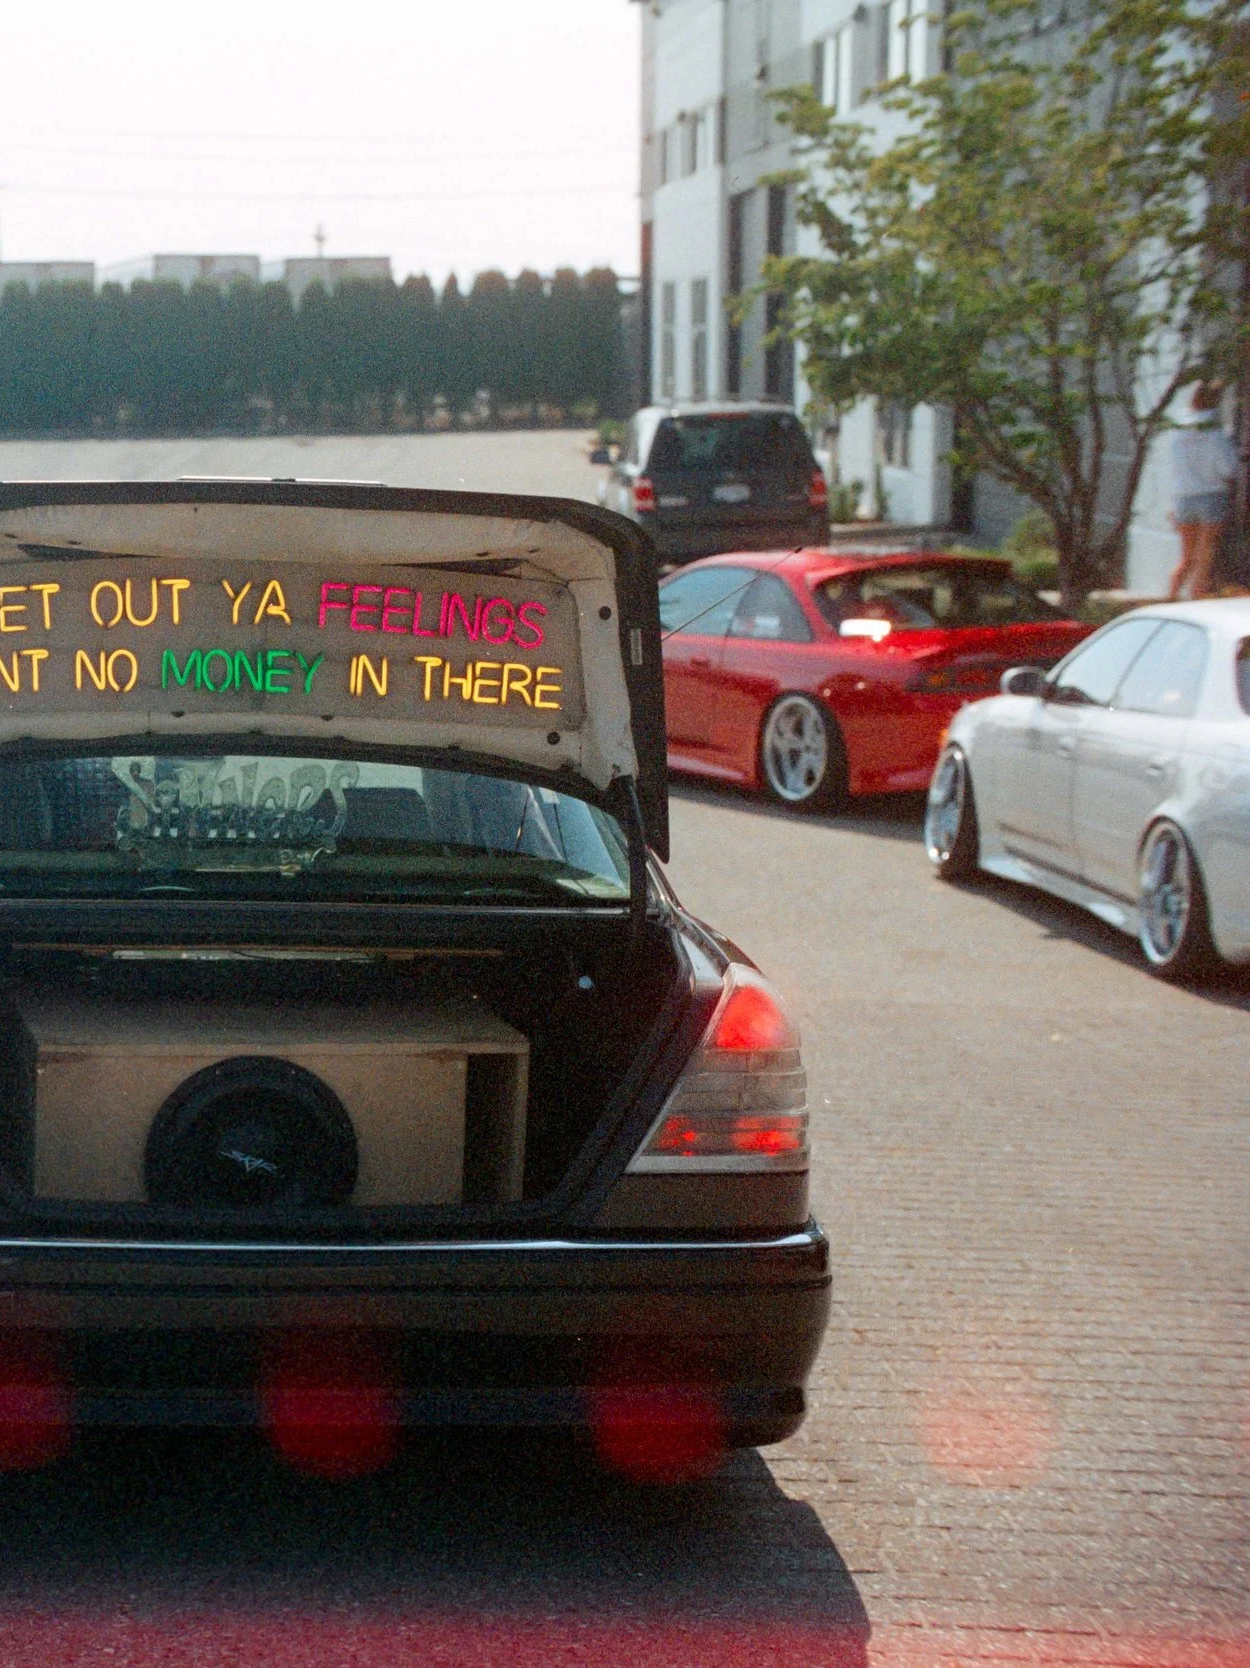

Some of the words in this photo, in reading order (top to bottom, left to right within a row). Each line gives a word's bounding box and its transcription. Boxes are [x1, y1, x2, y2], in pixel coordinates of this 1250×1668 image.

[90, 578, 191, 627] OUT
[223, 579, 292, 625] YA
[319, 582, 547, 648] FEELINGS
[75, 648, 139, 693] NO
[162, 650, 322, 694] MONEY
[350, 655, 390, 697] IN
[415, 656, 563, 710] THERE
